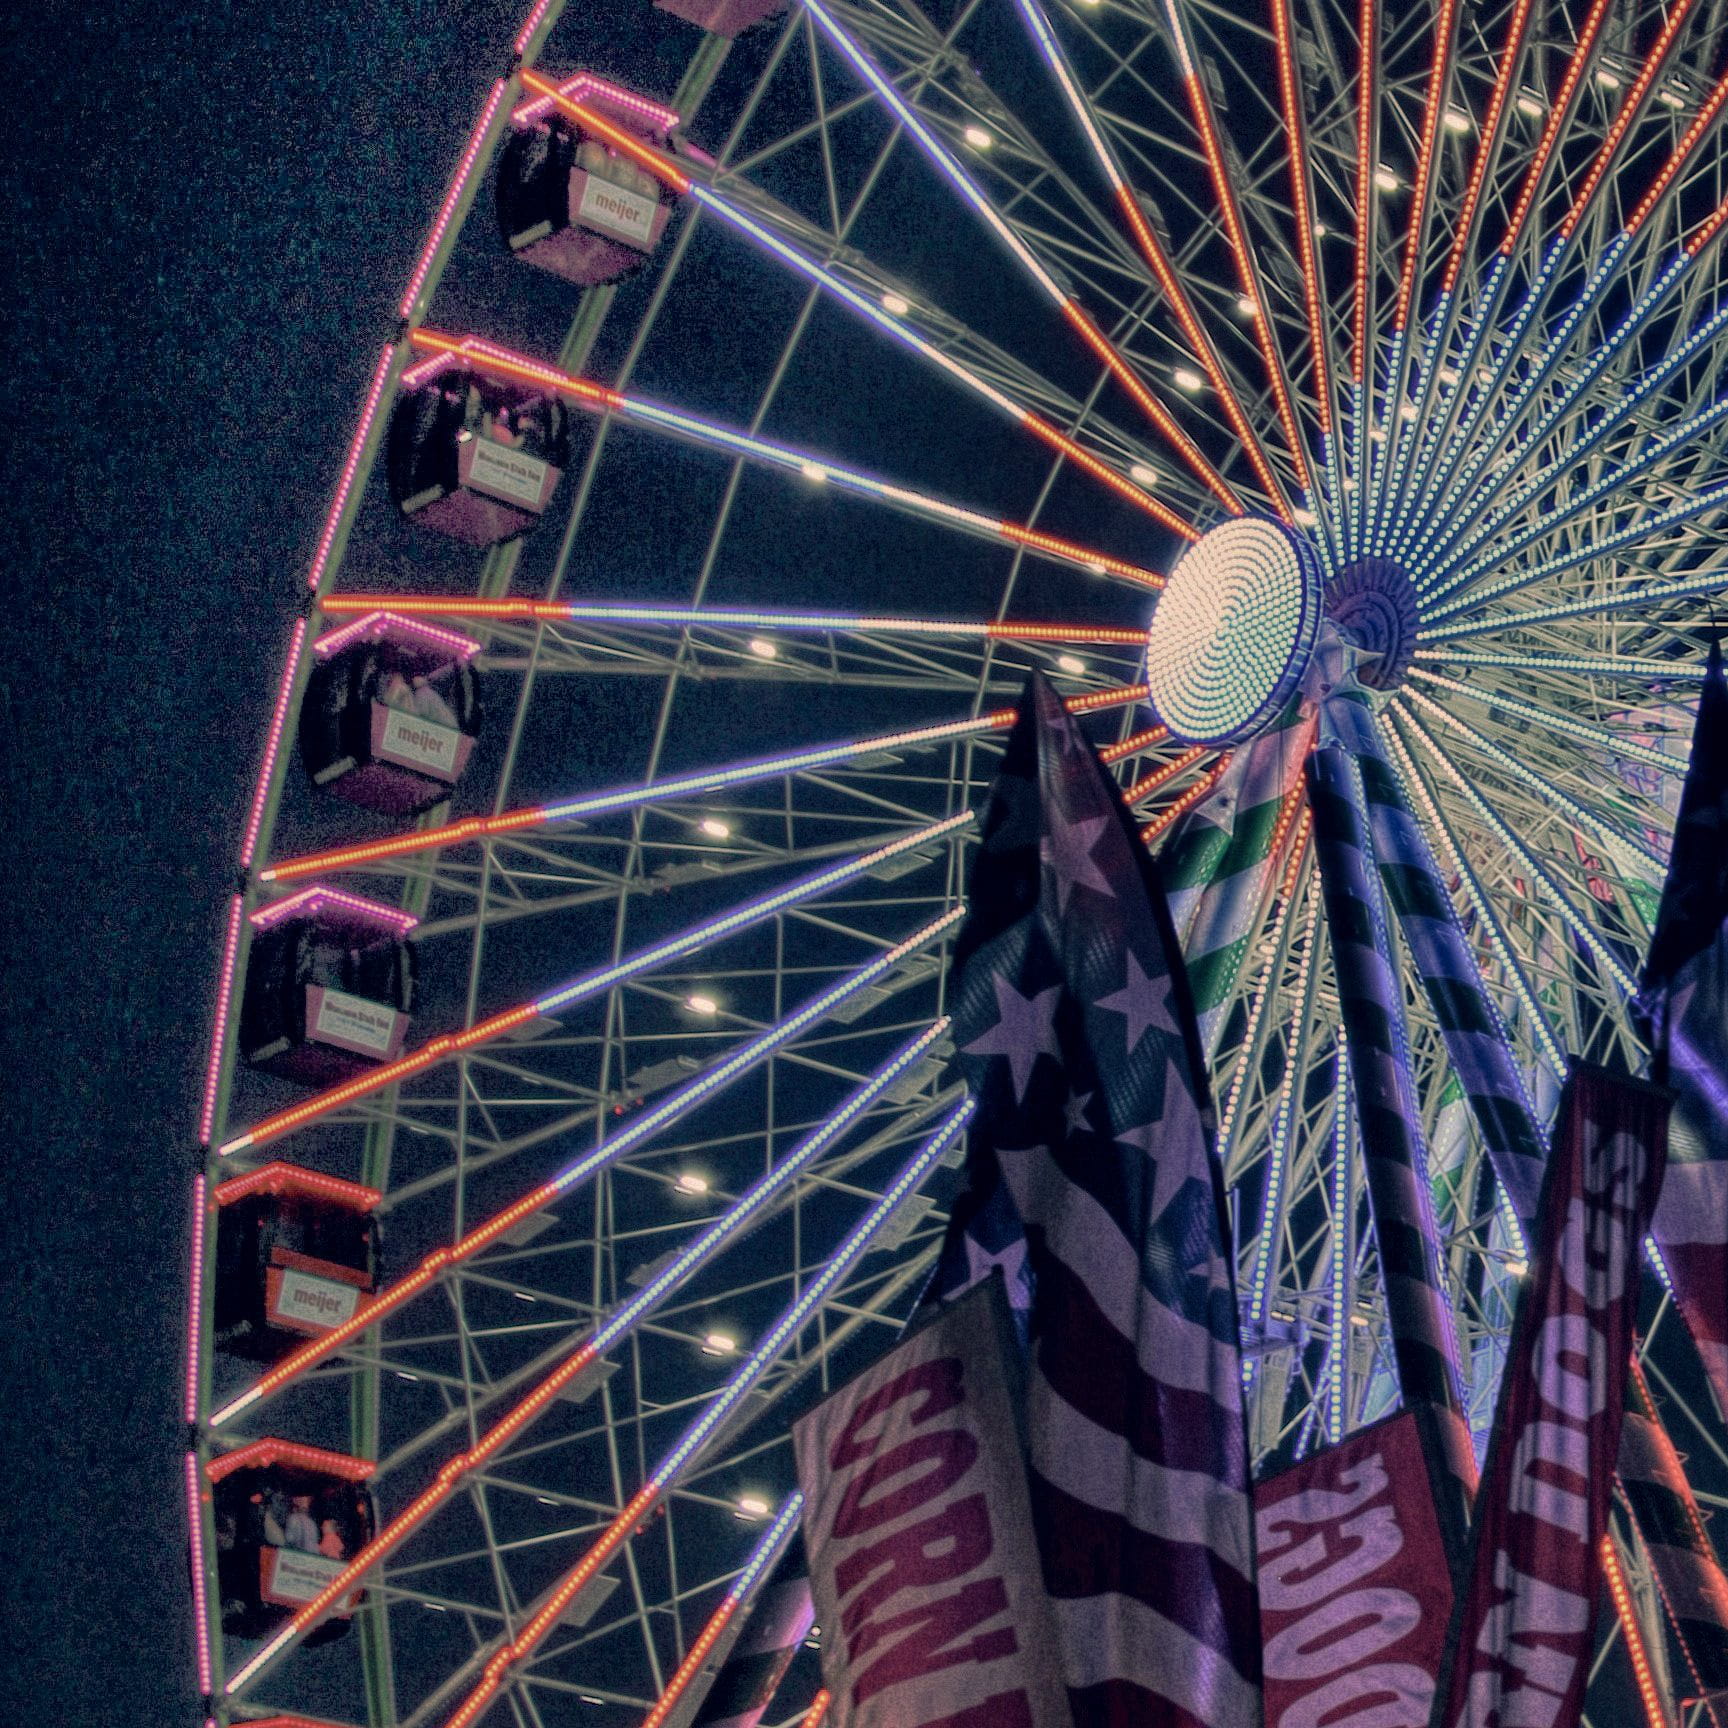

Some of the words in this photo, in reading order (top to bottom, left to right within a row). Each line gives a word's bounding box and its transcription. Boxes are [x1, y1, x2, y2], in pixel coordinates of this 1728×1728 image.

[596, 193, 640, 222] meijer
[398, 725, 443, 753] meijer
[293, 1288, 341, 1313] meijer
[1507, 1120, 1648, 1537] DOGS
[833, 1358, 1019, 1707] CORN
